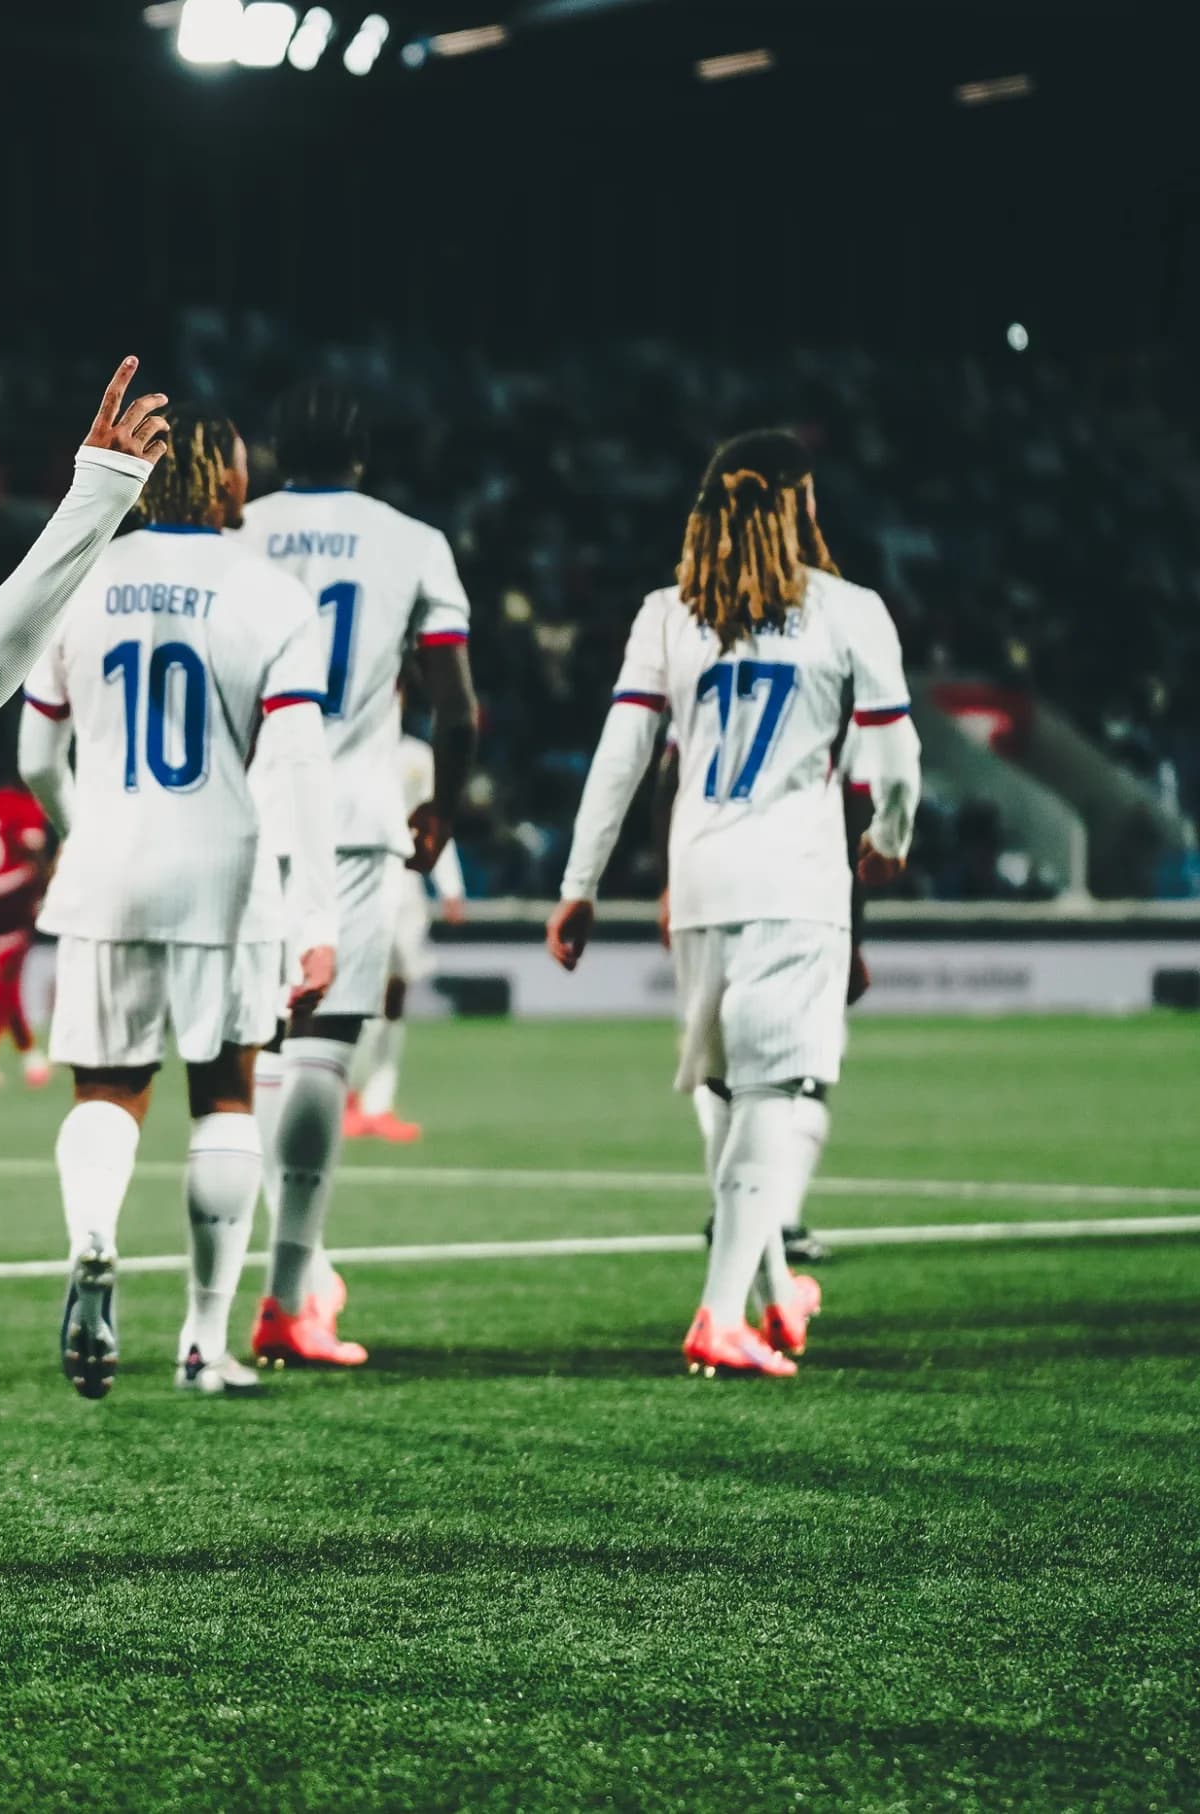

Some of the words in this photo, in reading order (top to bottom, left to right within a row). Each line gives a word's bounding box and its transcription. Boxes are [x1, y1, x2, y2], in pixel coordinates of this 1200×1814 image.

[267, 533, 359, 559] CANVOT
[105, 583, 217, 618] ODOBERT
[103, 639, 209, 794] 10
[696, 659, 801, 804] 17
